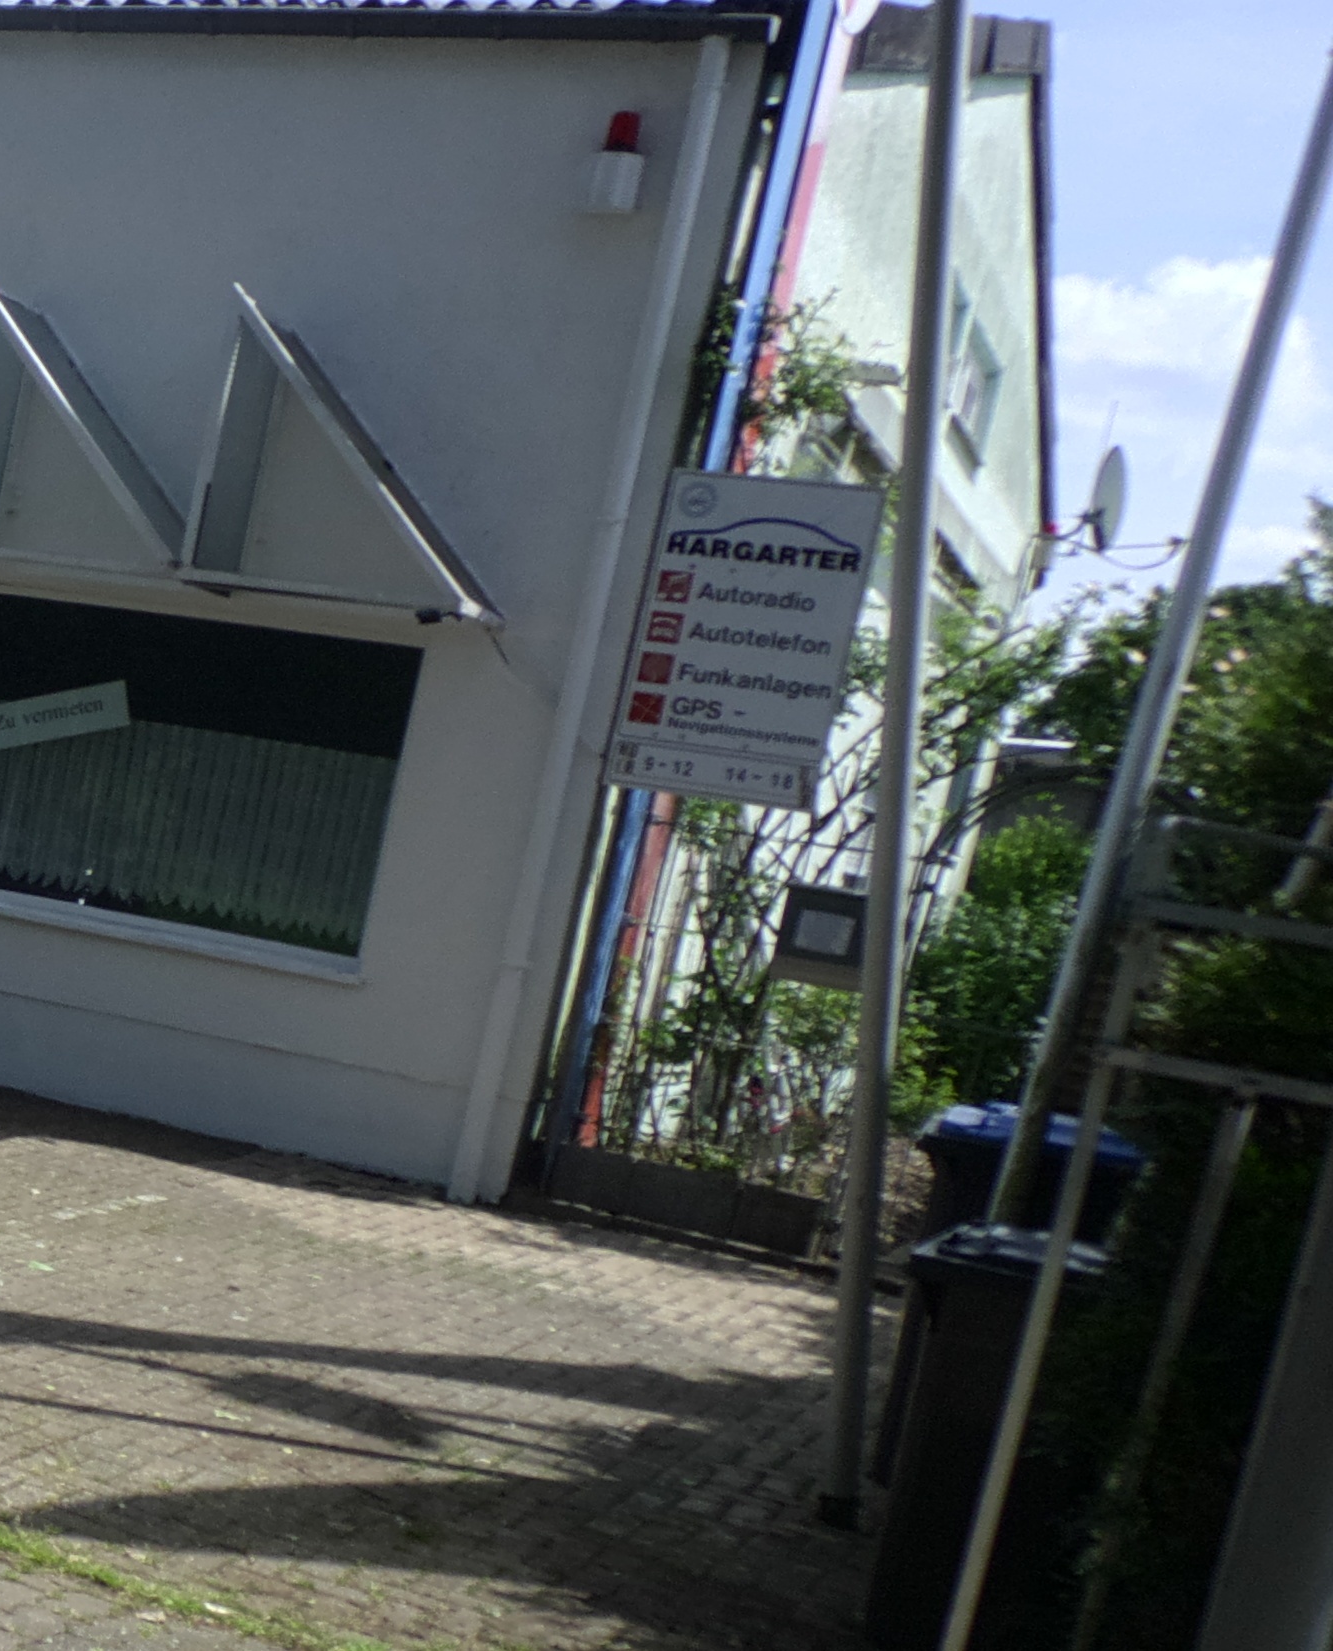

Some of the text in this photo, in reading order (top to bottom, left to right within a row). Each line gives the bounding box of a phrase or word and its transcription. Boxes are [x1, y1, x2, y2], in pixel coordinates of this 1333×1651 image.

[667, 533, 862, 572] HARGARTER
[698, 581, 816, 612] Autoradio
[688, 622, 831, 656] Autotelefon
[677, 663, 832, 699] Funkanlagen
[22, 699, 103, 724] vermieten
[671, 696, 723, 719] GPS
